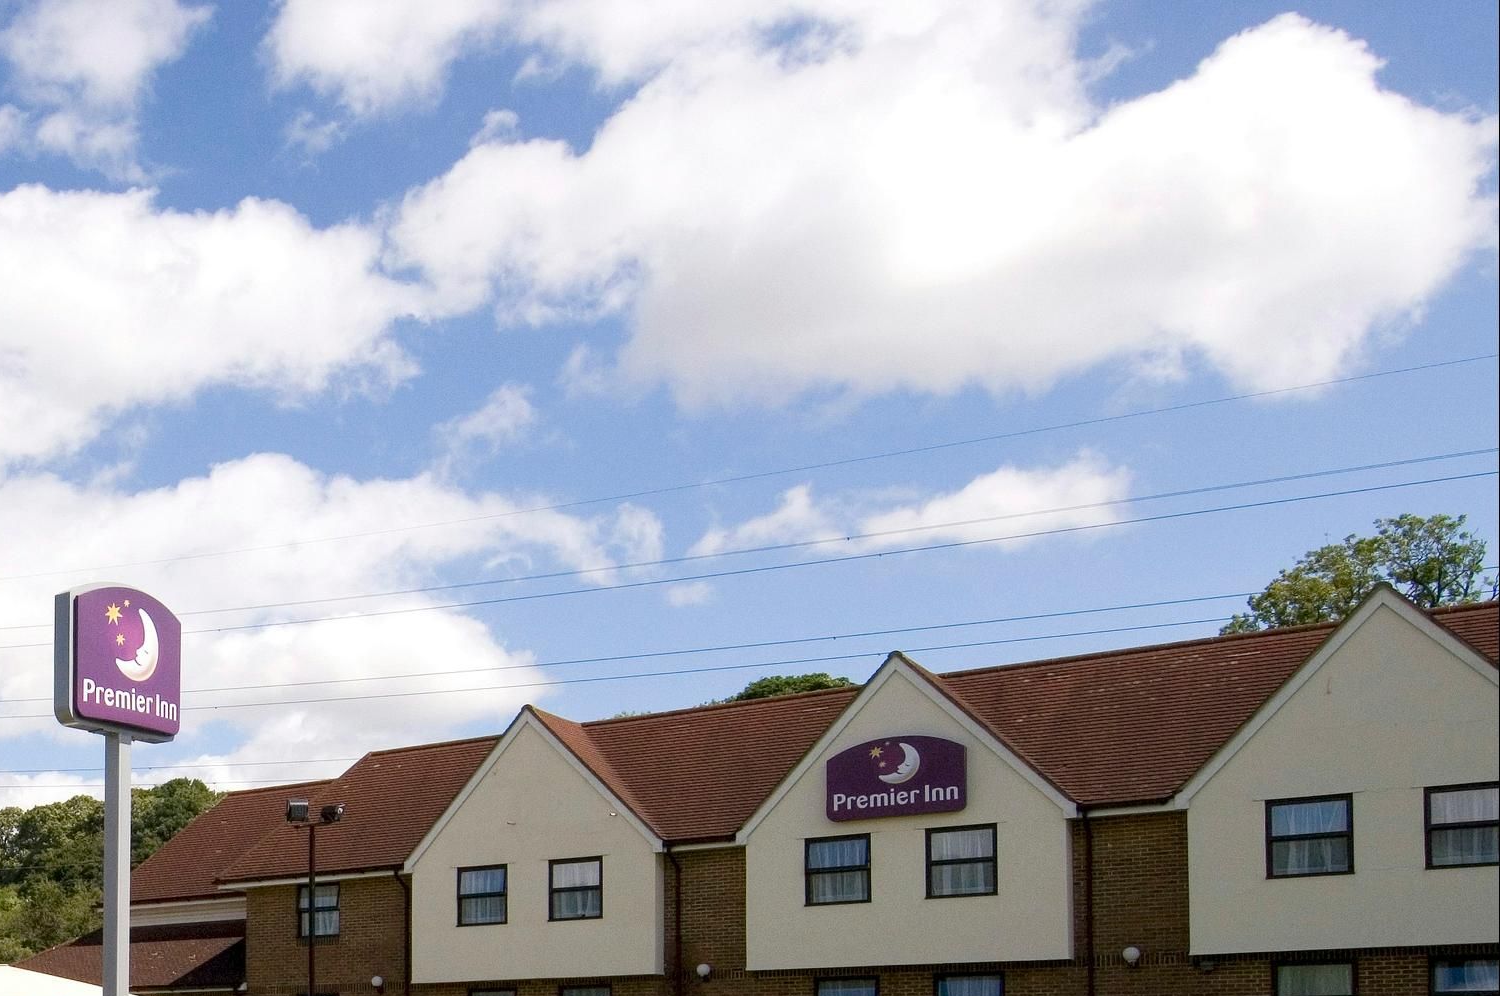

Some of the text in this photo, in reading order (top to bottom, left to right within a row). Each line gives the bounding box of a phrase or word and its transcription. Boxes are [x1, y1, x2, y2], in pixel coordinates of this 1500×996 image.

[82, 678, 177, 721] Premier Inn
[833, 784, 959, 812] Premier Inn
